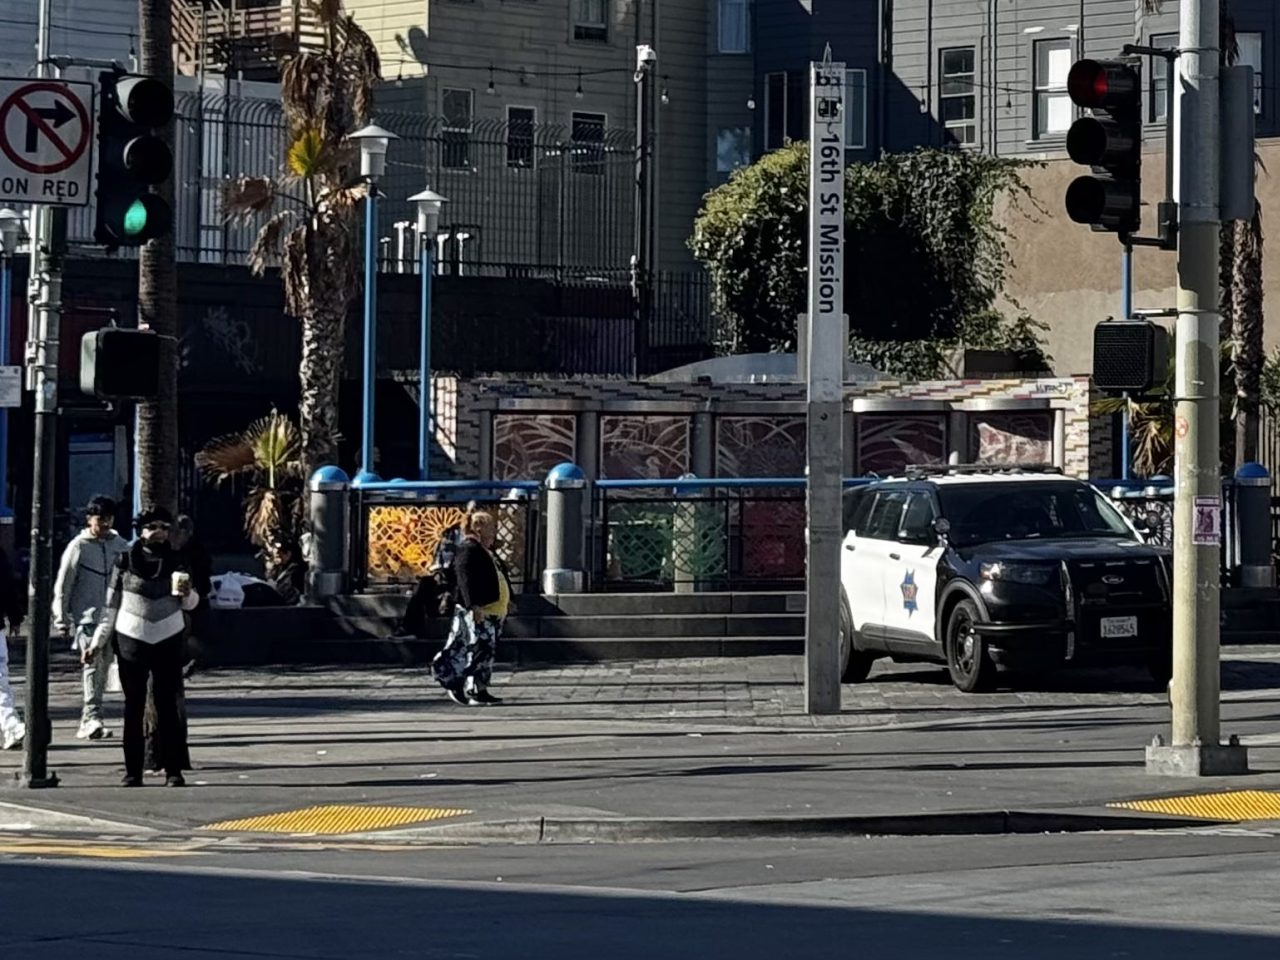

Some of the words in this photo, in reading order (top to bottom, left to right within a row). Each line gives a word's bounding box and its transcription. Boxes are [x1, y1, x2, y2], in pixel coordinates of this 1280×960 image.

[820, 134, 840, 182] 16th
[2, 177, 29, 195] ON
[42, 179, 79, 198] RED
[820, 193, 840, 215] St
[819, 225, 840, 313] Mission
